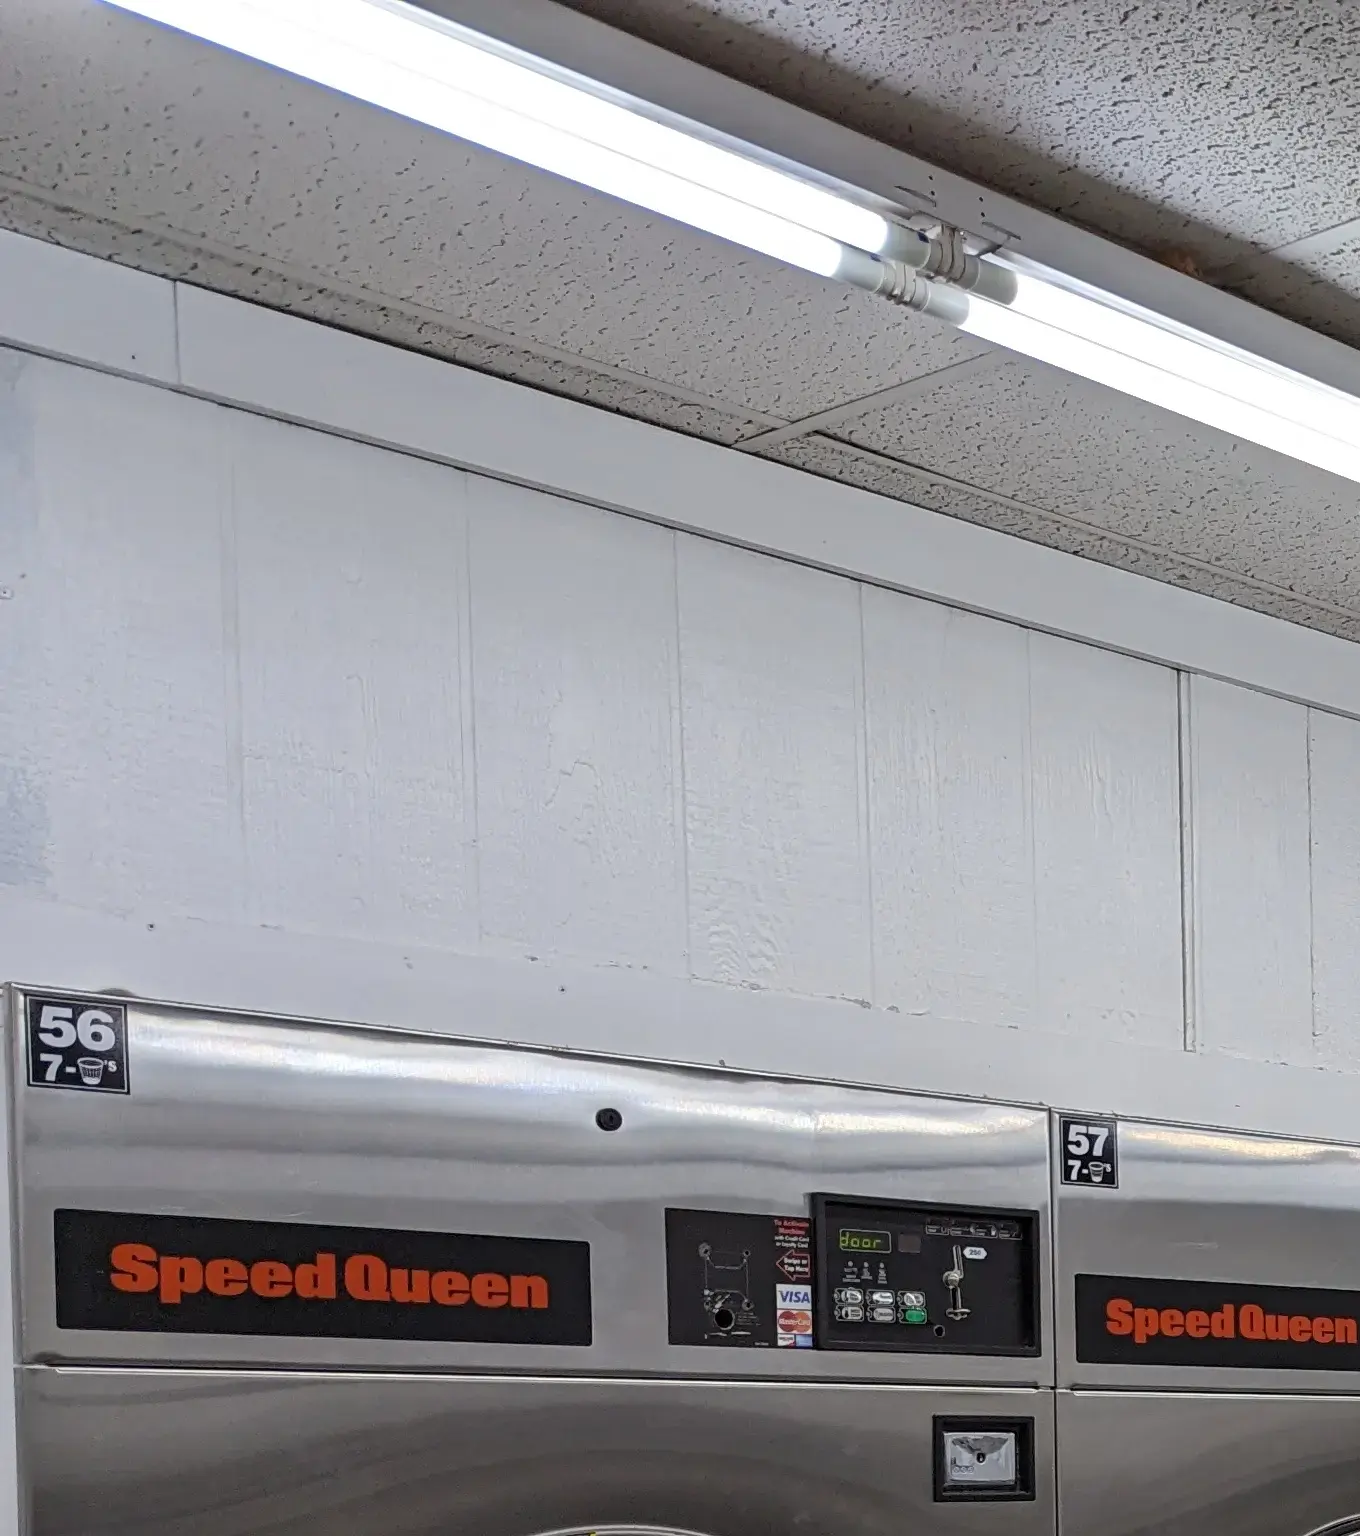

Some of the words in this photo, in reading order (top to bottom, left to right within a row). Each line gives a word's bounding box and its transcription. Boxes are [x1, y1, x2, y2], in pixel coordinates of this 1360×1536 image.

[38, 1005, 115, 1051] 56
[1067, 1124, 1108, 1156] 57
[110, 1243, 336, 1303] Speed
[344, 1254, 548, 1308] Queen
[778, 1290, 810, 1303] VISA
[1106, 1298, 1235, 1343] Speed
[1239, 1304, 1358, 1343] Queen
